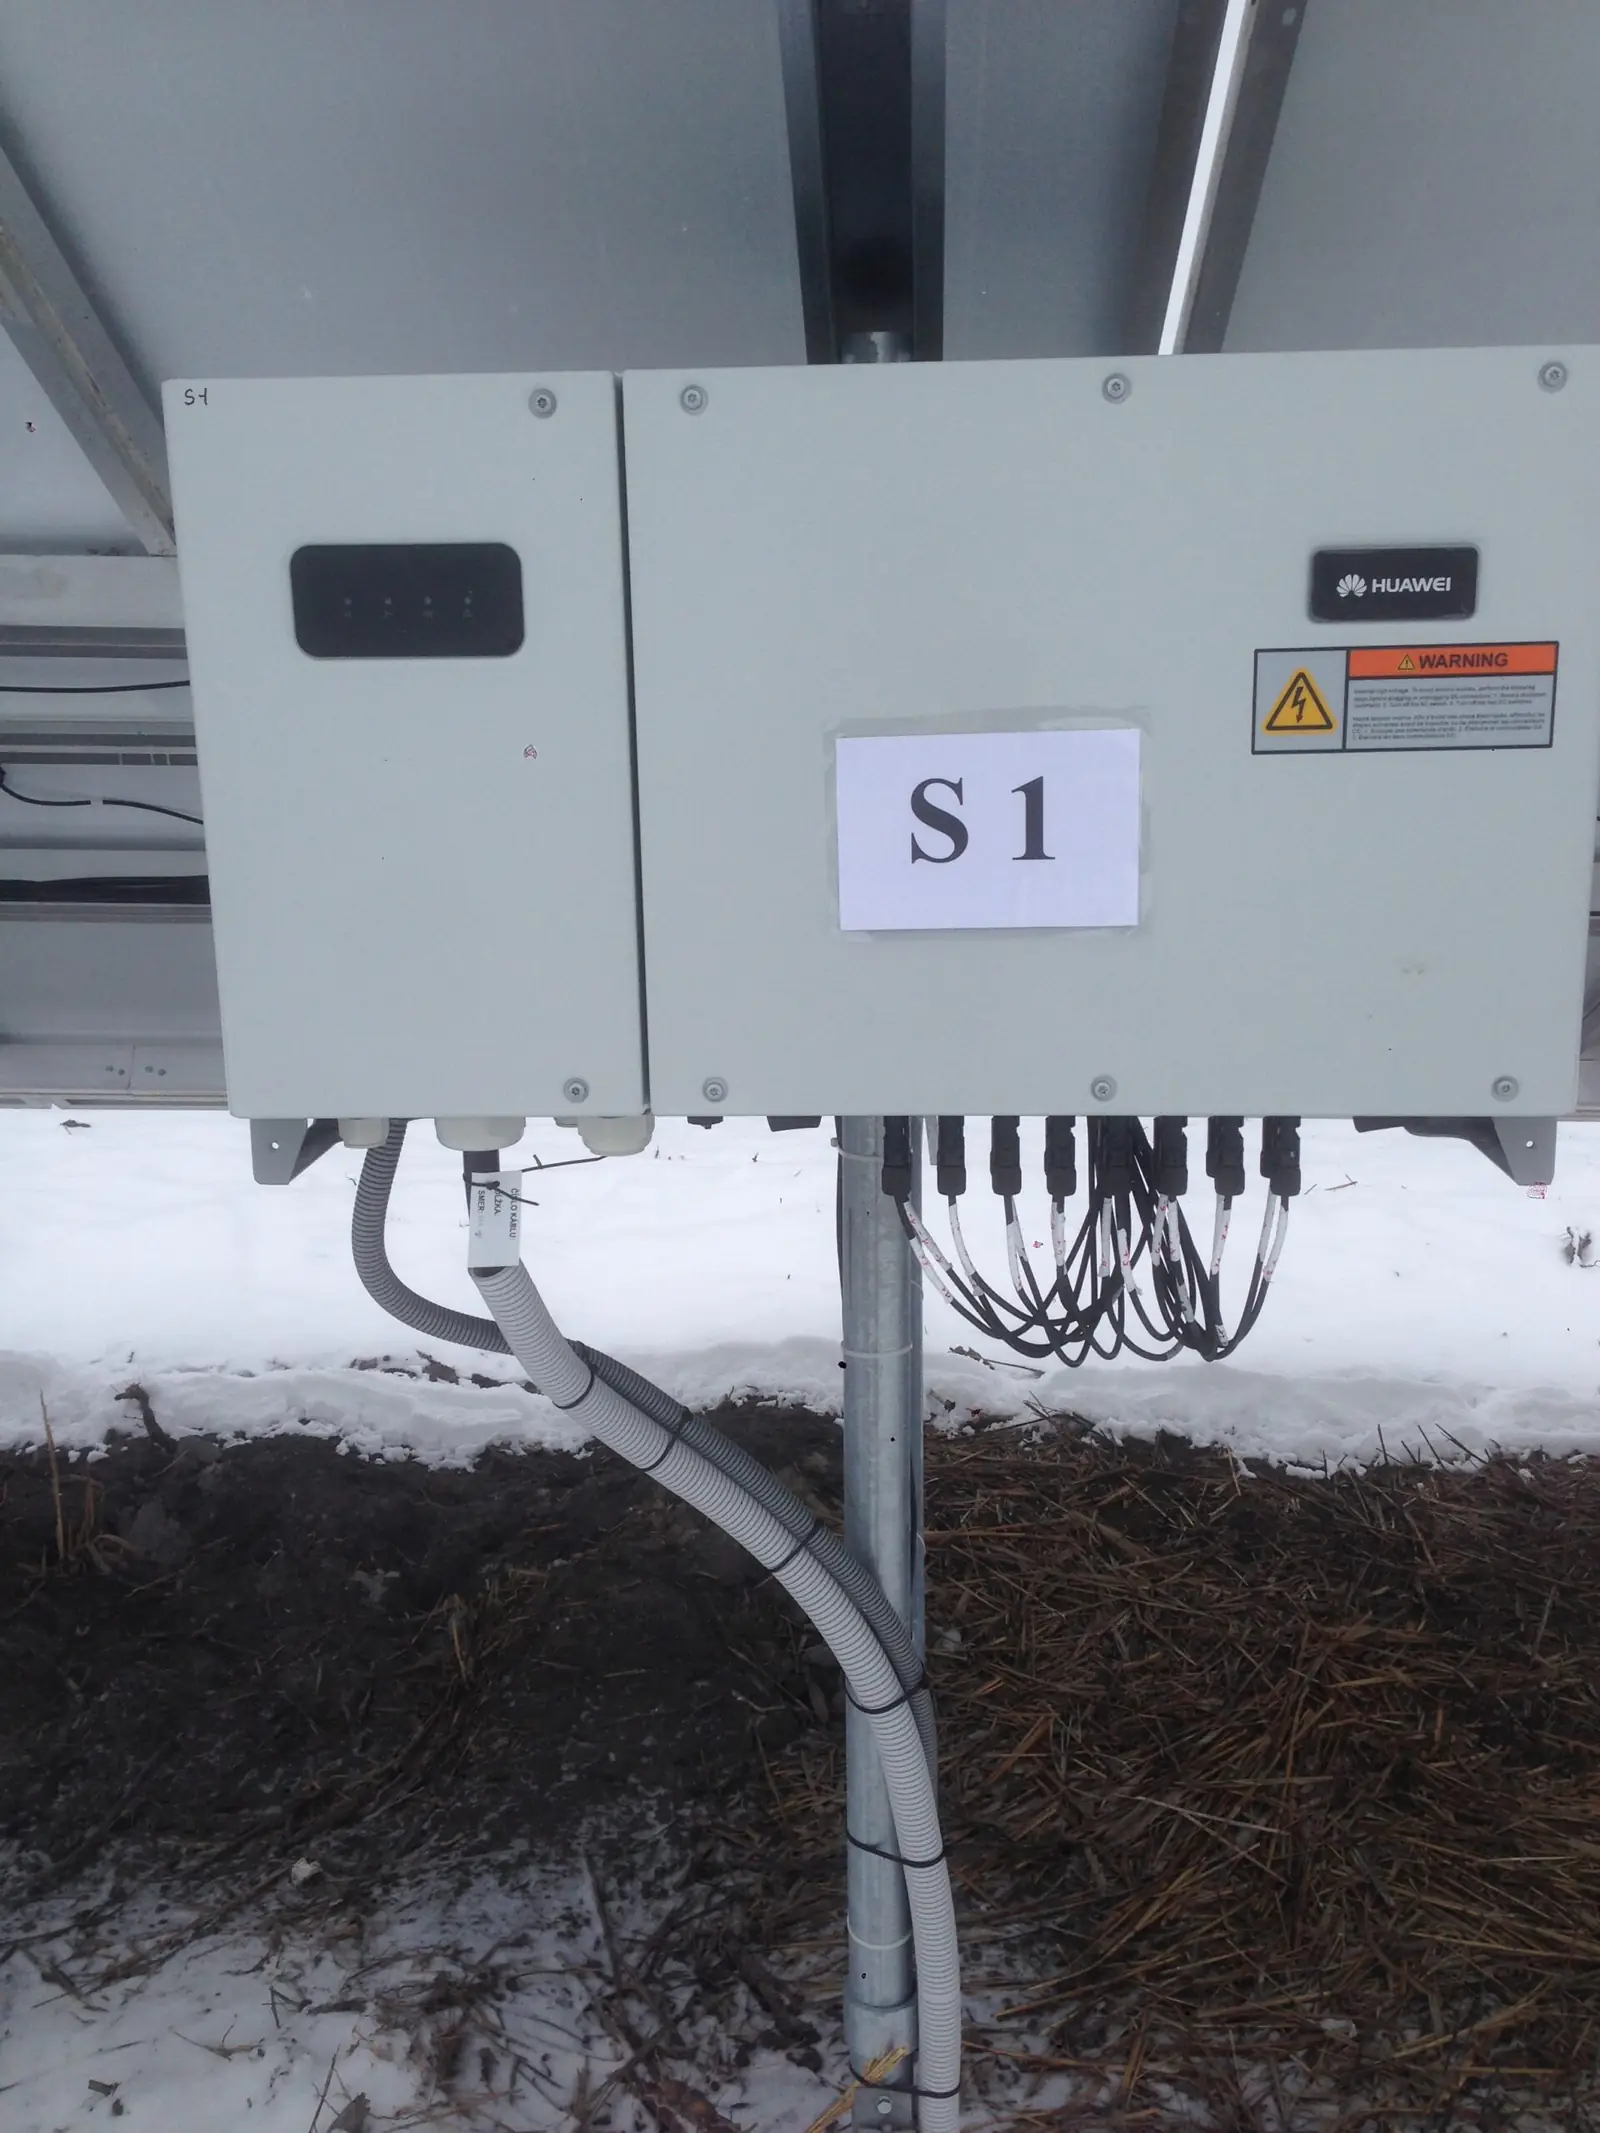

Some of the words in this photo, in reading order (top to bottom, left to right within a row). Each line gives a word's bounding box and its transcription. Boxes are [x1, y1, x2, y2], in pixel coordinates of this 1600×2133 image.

[1371, 577, 1452, 593] HUAWEI
[1418, 652, 1508, 670] WARNING
[910, 777, 969, 864] S
[1010, 775, 1056, 861] 1
